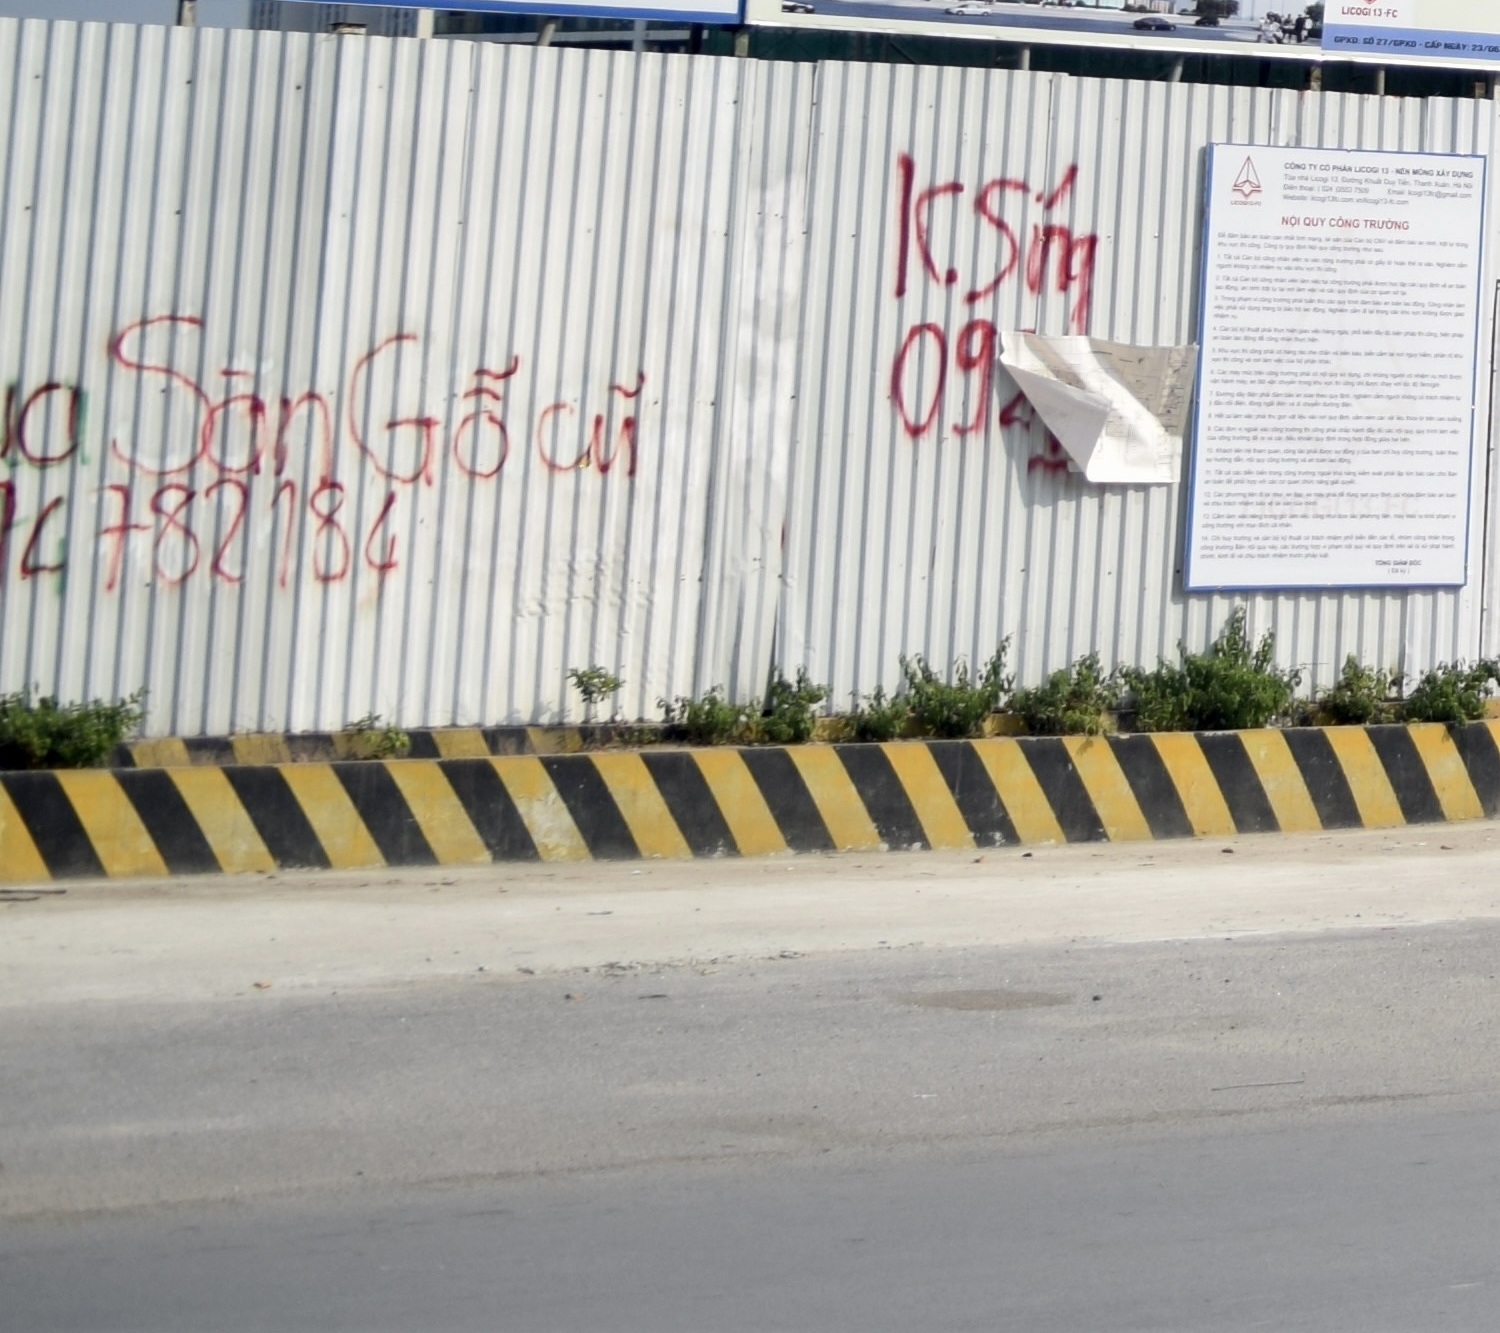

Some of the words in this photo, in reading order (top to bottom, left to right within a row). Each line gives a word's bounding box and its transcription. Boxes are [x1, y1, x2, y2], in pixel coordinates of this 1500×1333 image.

[1281, 215, 1300, 228] NỘI
[1303, 217, 1326, 228] QUY
[1329, 216, 1360, 229] CÔNG
[1363, 219, 1410, 231] TRƯỜNG
